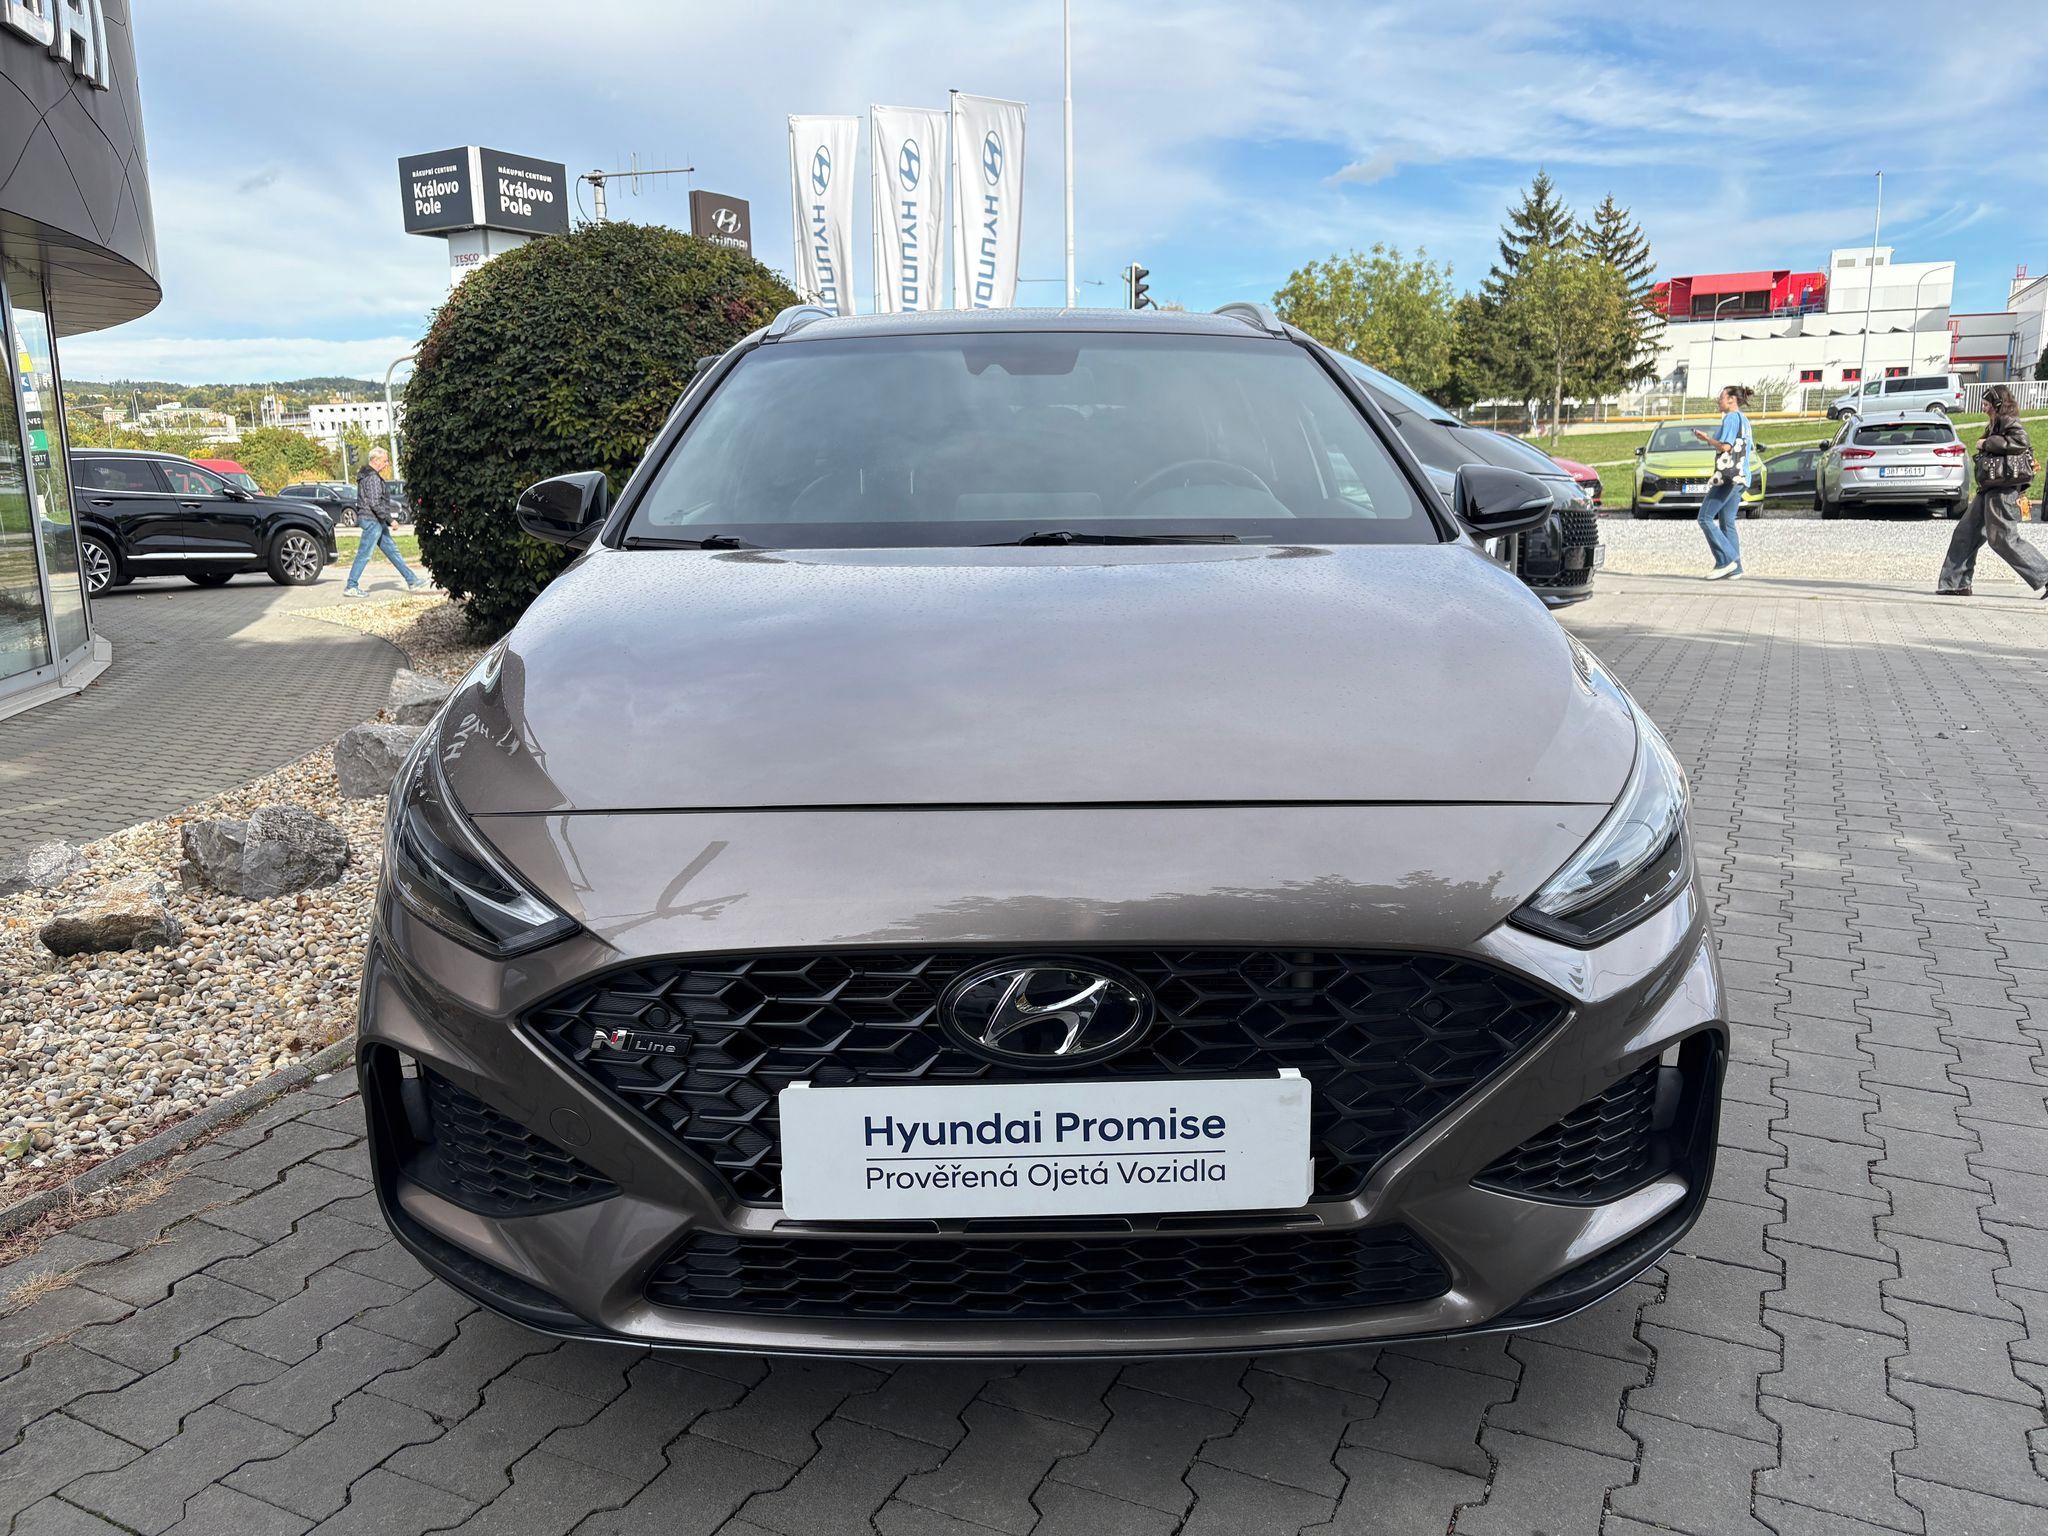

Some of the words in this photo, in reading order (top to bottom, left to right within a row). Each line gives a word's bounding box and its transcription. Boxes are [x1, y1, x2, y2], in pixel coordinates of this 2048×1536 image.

[498, 166, 524, 178] NÁKUPNÍ
[525, 172, 552, 183] CENTRUM
[413, 179, 459, 199] Královo
[499, 178, 553, 203] Královo
[415, 197, 441, 216] Pole
[500, 195, 532, 216] Pole
[454, 253, 479, 263] TESCO
[812, 205, 839, 316] HYUND
[902, 201, 919, 311] HYUND
[974, 195, 998, 308] HYUND
[634, 1040, 676, 1053] Line
[865, 1111, 1041, 1153] Hyundai
[1055, 1107, 1226, 1142] Promise
[866, 1163, 1018, 1189] Prověřená
[1027, 1161, 1108, 1192] Ojetá
[1116, 1158, 1226, 1184] Vozidla
